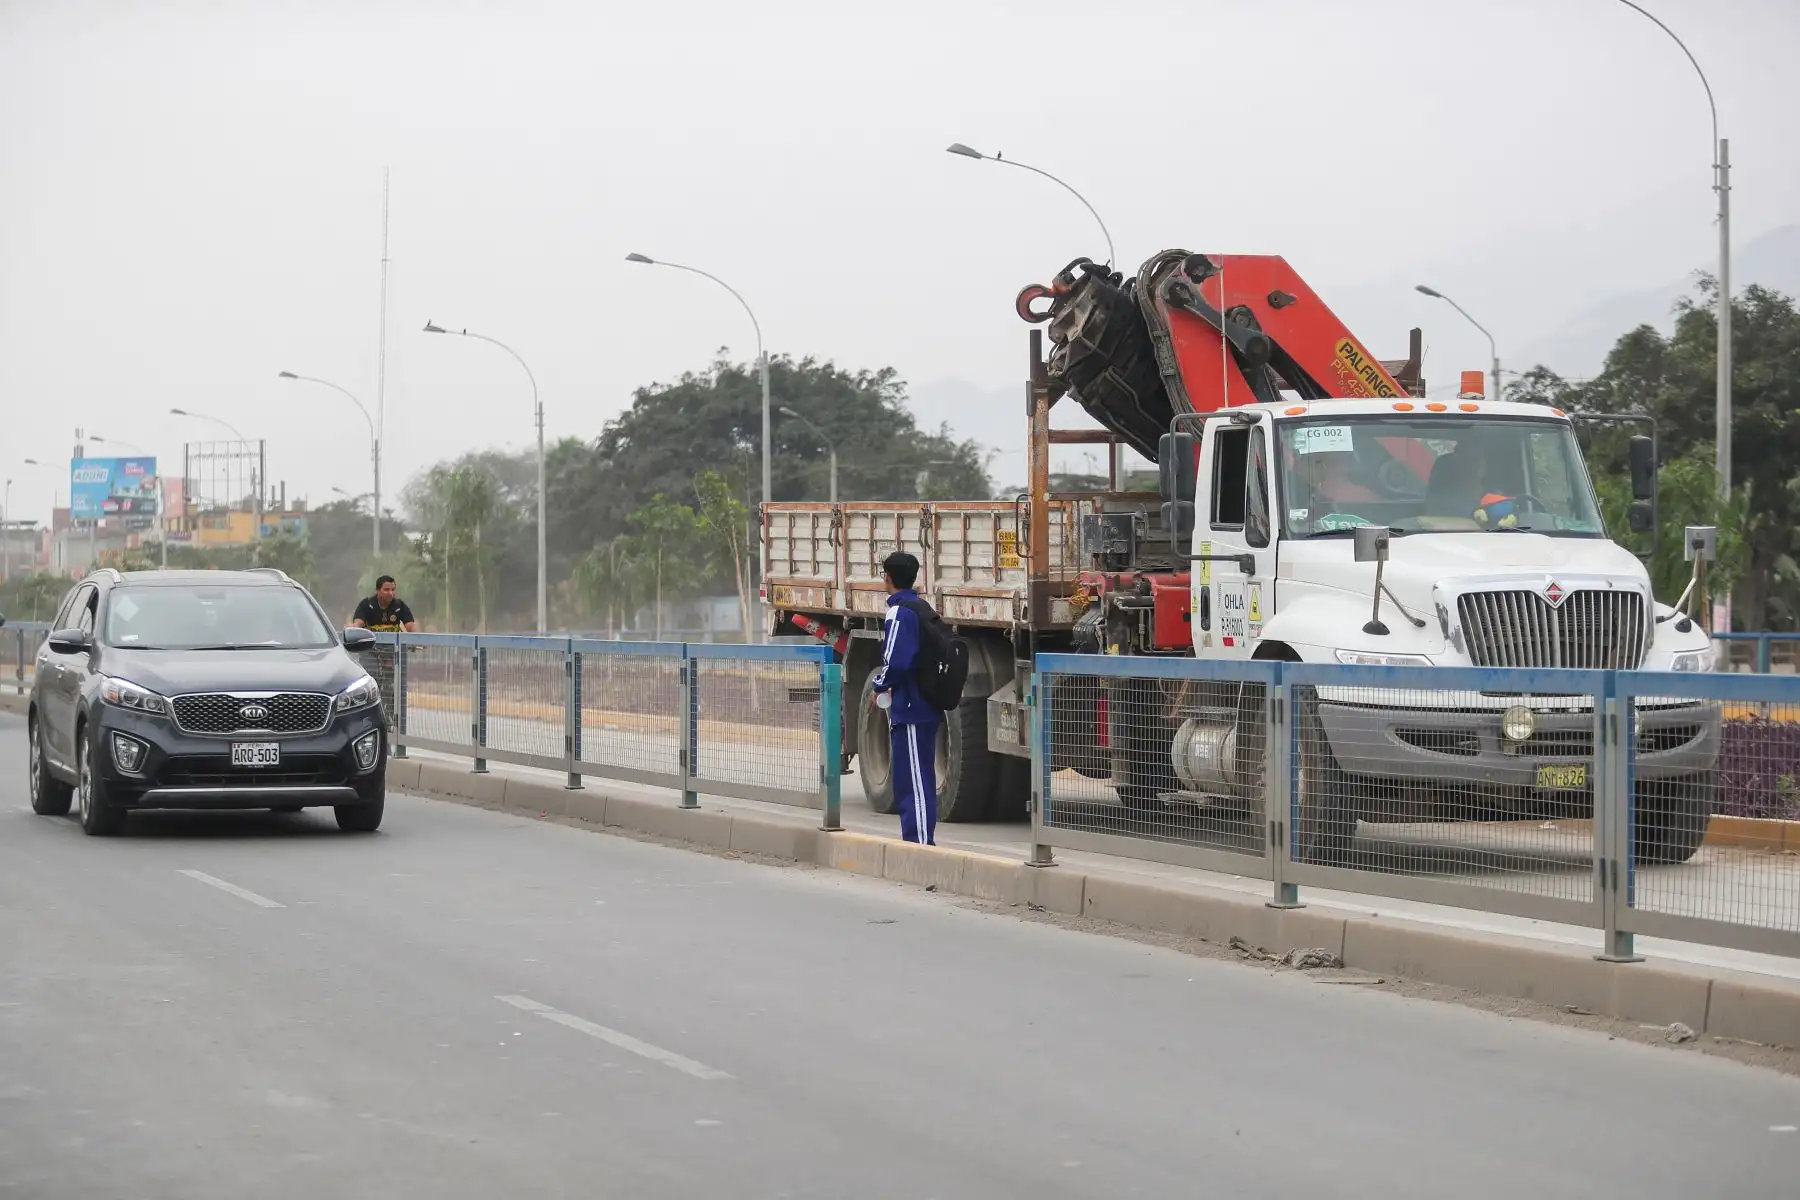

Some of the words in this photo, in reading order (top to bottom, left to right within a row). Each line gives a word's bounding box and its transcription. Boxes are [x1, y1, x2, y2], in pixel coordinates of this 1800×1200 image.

[1330, 359, 1349, 379] PK
[1307, 429, 1321, 438] CG
[1323, 428, 1343, 437] 002
[1224, 594, 1244, 610] OHLA
[244, 708, 264, 718] KIA
[233, 748, 278, 763] ARQ-503
